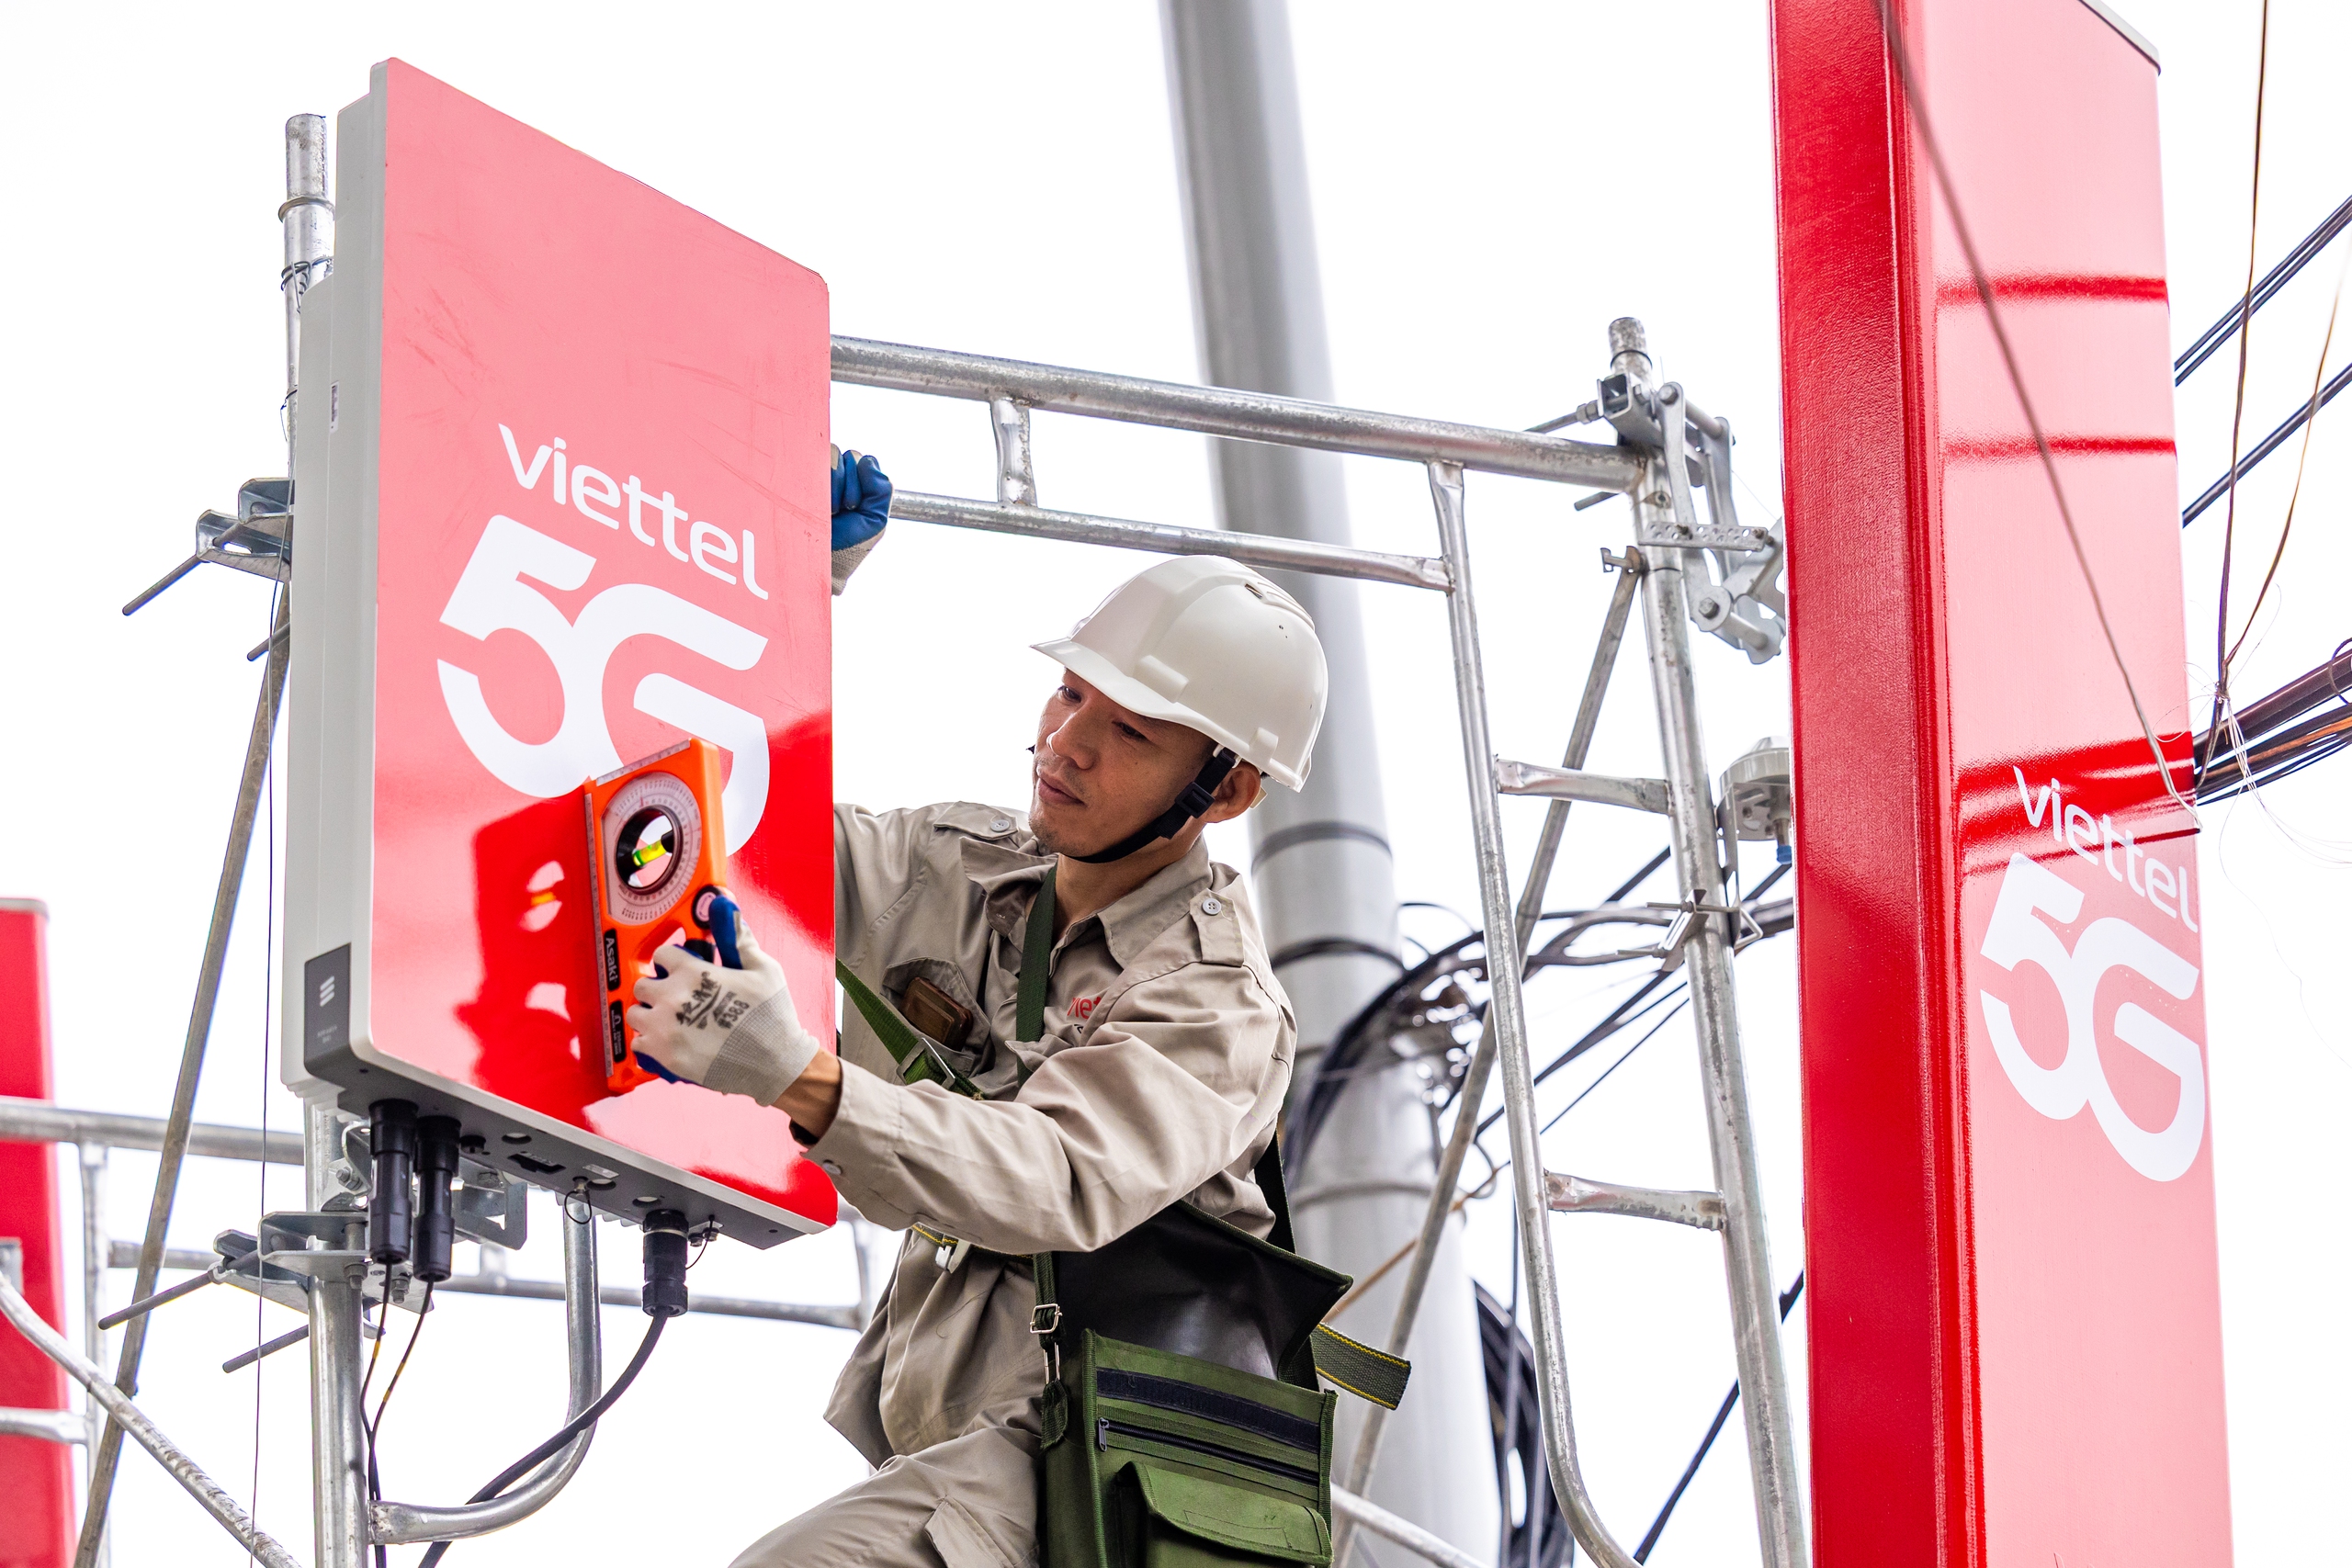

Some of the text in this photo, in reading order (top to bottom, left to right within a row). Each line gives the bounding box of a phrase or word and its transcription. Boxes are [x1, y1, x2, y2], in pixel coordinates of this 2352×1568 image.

[498, 423, 769, 601] viettel
[436, 514, 770, 857] 5G
[2013, 765, 2199, 933] viettel
[605, 937, 618, 982] Asaki
[1980, 852, 2206, 1182] 5G
